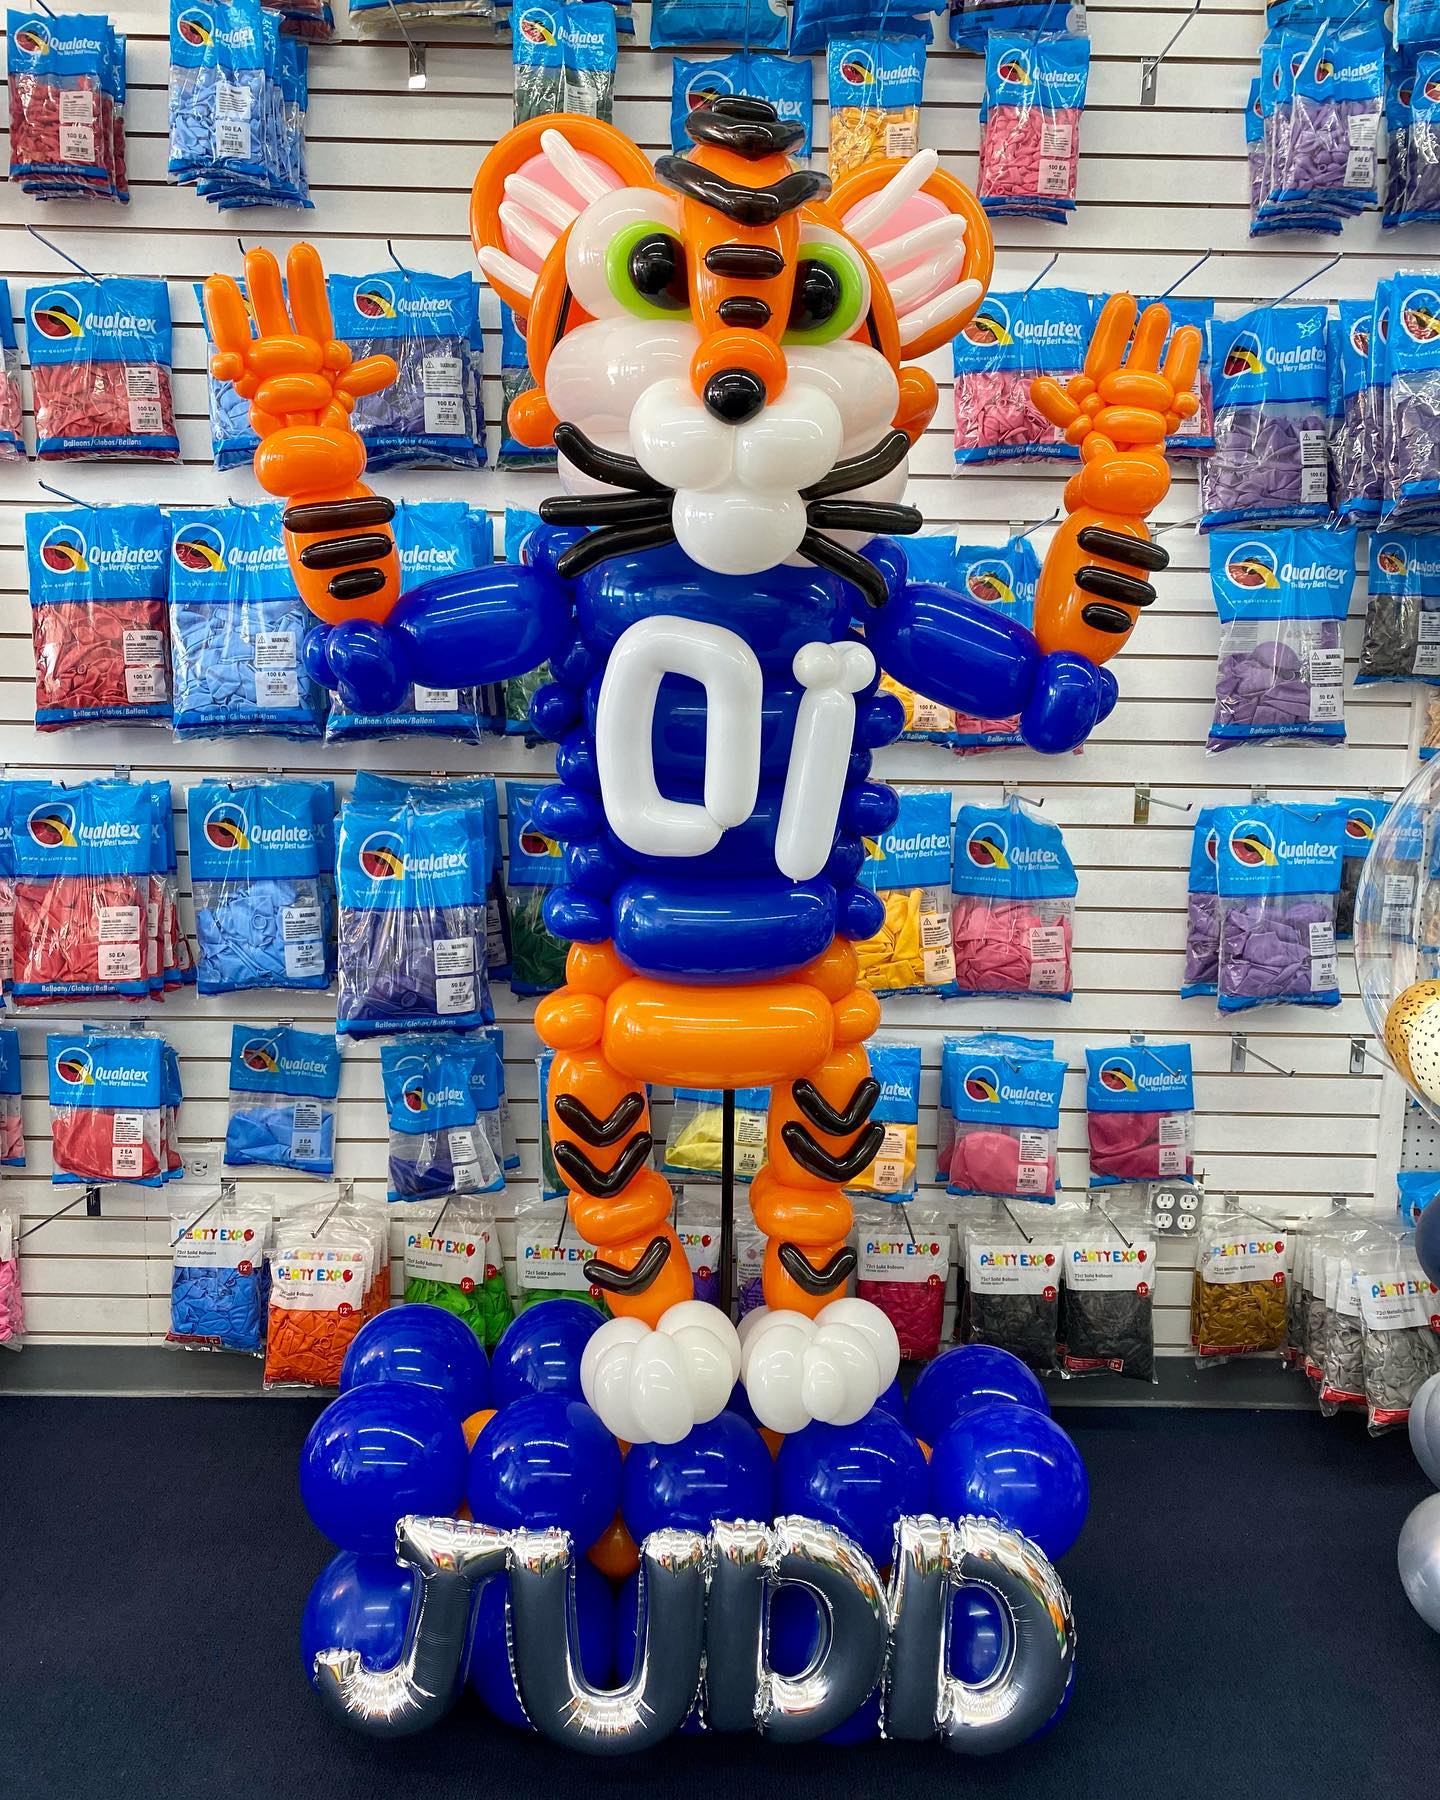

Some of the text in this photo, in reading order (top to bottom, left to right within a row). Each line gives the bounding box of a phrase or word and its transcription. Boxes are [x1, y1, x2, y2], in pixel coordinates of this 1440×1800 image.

[215, 28, 254, 44] ualatex
[50, 38, 101, 52] Qualatex
[1033, 67, 1081, 83] Qualatex
[1333, 61, 1378, 81] ualatex
[85, 312, 156, 334] Qualatex
[1014, 320, 1082, 340] Qualatex
[117, 329, 133, 337] Best
[1298, 363, 1313, 371] Best
[89, 545, 164, 564] Qualatex
[228, 546, 288, 566] Qualate
[108, 563, 124, 572] Very
[124, 563, 140, 571] Best
[246, 564, 259, 573] Very
[416, 563, 431, 571] Best
[1280, 562, 1348, 584] Qualatex
[90, 839, 103, 848] Very
[104, 838, 117, 847] Best
[269, 843, 284, 851] Very
[1278, 840, 1337, 860] Qualatex
[904, 852, 918, 860] Very
[1294, 857, 1306, 866] Very
[432, 870, 446, 879] Best
[280, 1056, 327, 1074] Qualatex
[95, 1066, 149, 1082] Qualatex
[1138, 1073, 1187, 1088] Qualatex
[1001, 1085, 1054, 1105] Qualatex
[220, 1229, 254, 1242] EXPO
[408, 1233, 475, 1257] PARTY EXPO
[525, 1245, 566, 1260] PARTY
[866, 1242, 939, 1256] PARTY EXPO
[1213, 1241, 1284, 1257] PARTY EXPO
[980, 1253, 1055, 1267] PARTY EXPO
[1073, 1250, 1147, 1262] PARTY EXPO
[278, 1267, 353, 1282] PARTY EXPO
[1371, 1281, 1405, 1298] PARTY
[315, 1514, 1078, 1756] JUDD
